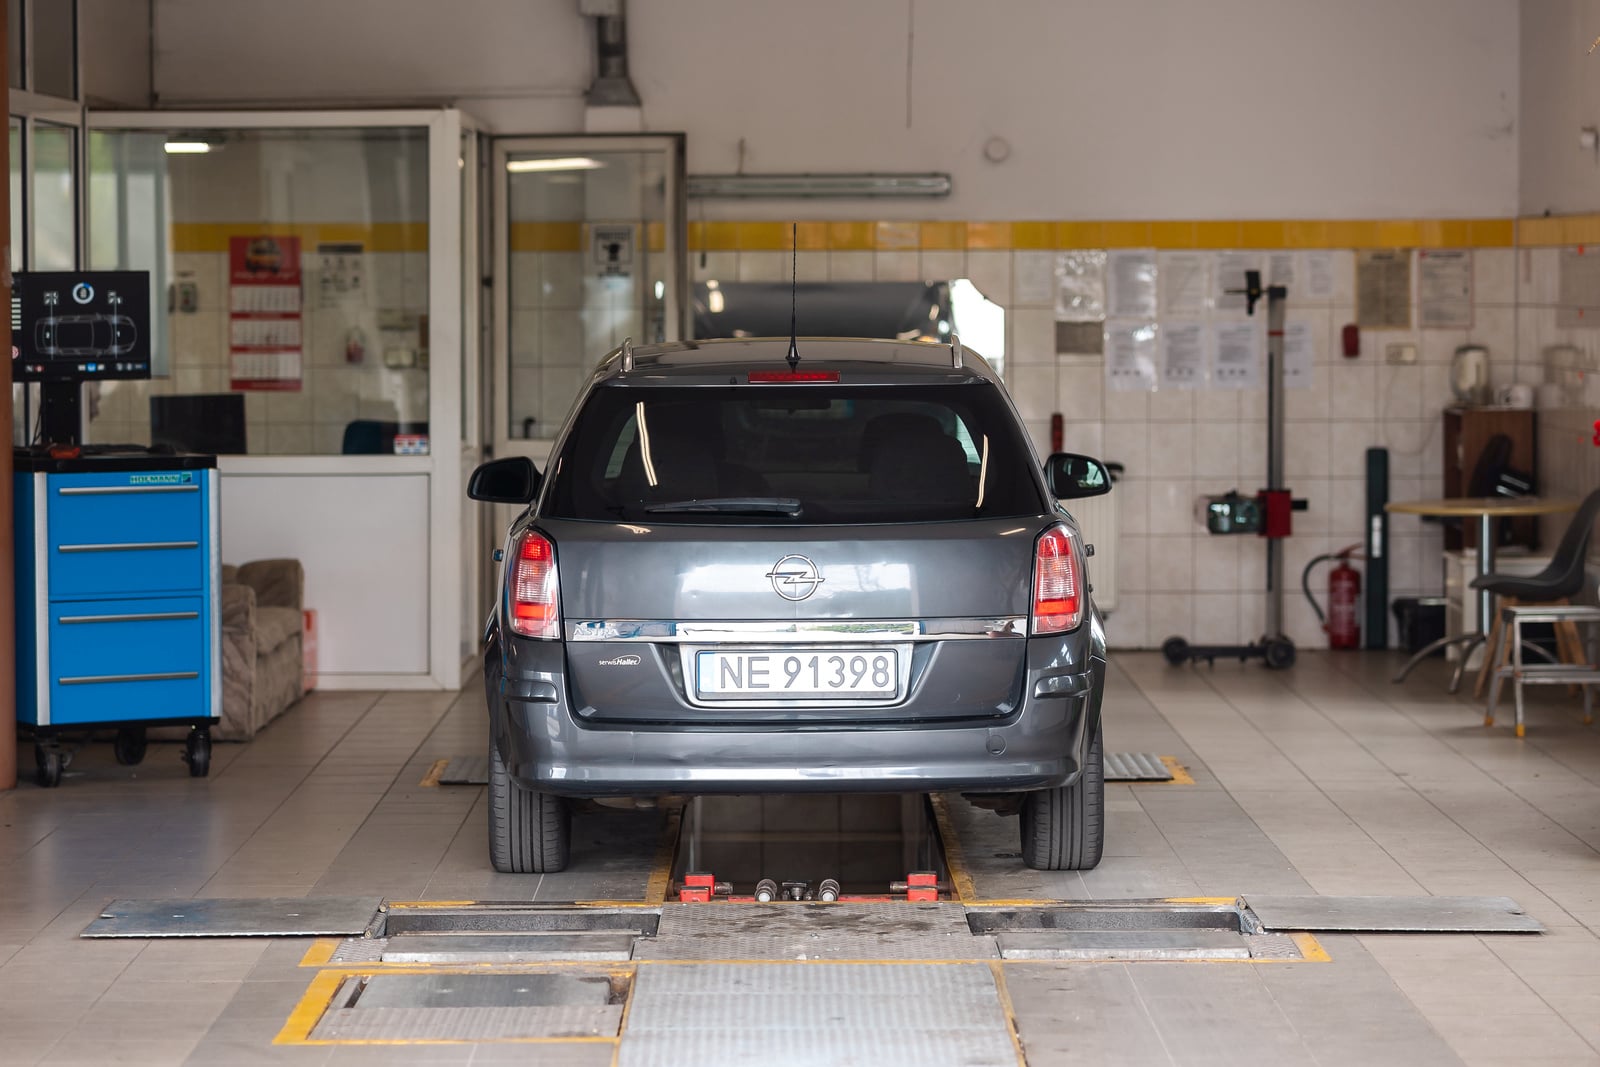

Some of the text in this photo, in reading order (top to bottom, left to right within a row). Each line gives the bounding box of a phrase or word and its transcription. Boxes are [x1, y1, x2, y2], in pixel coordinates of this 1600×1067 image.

[573, 626, 619, 636] ASTRA
[720, 655, 890, 689] NE 91398
